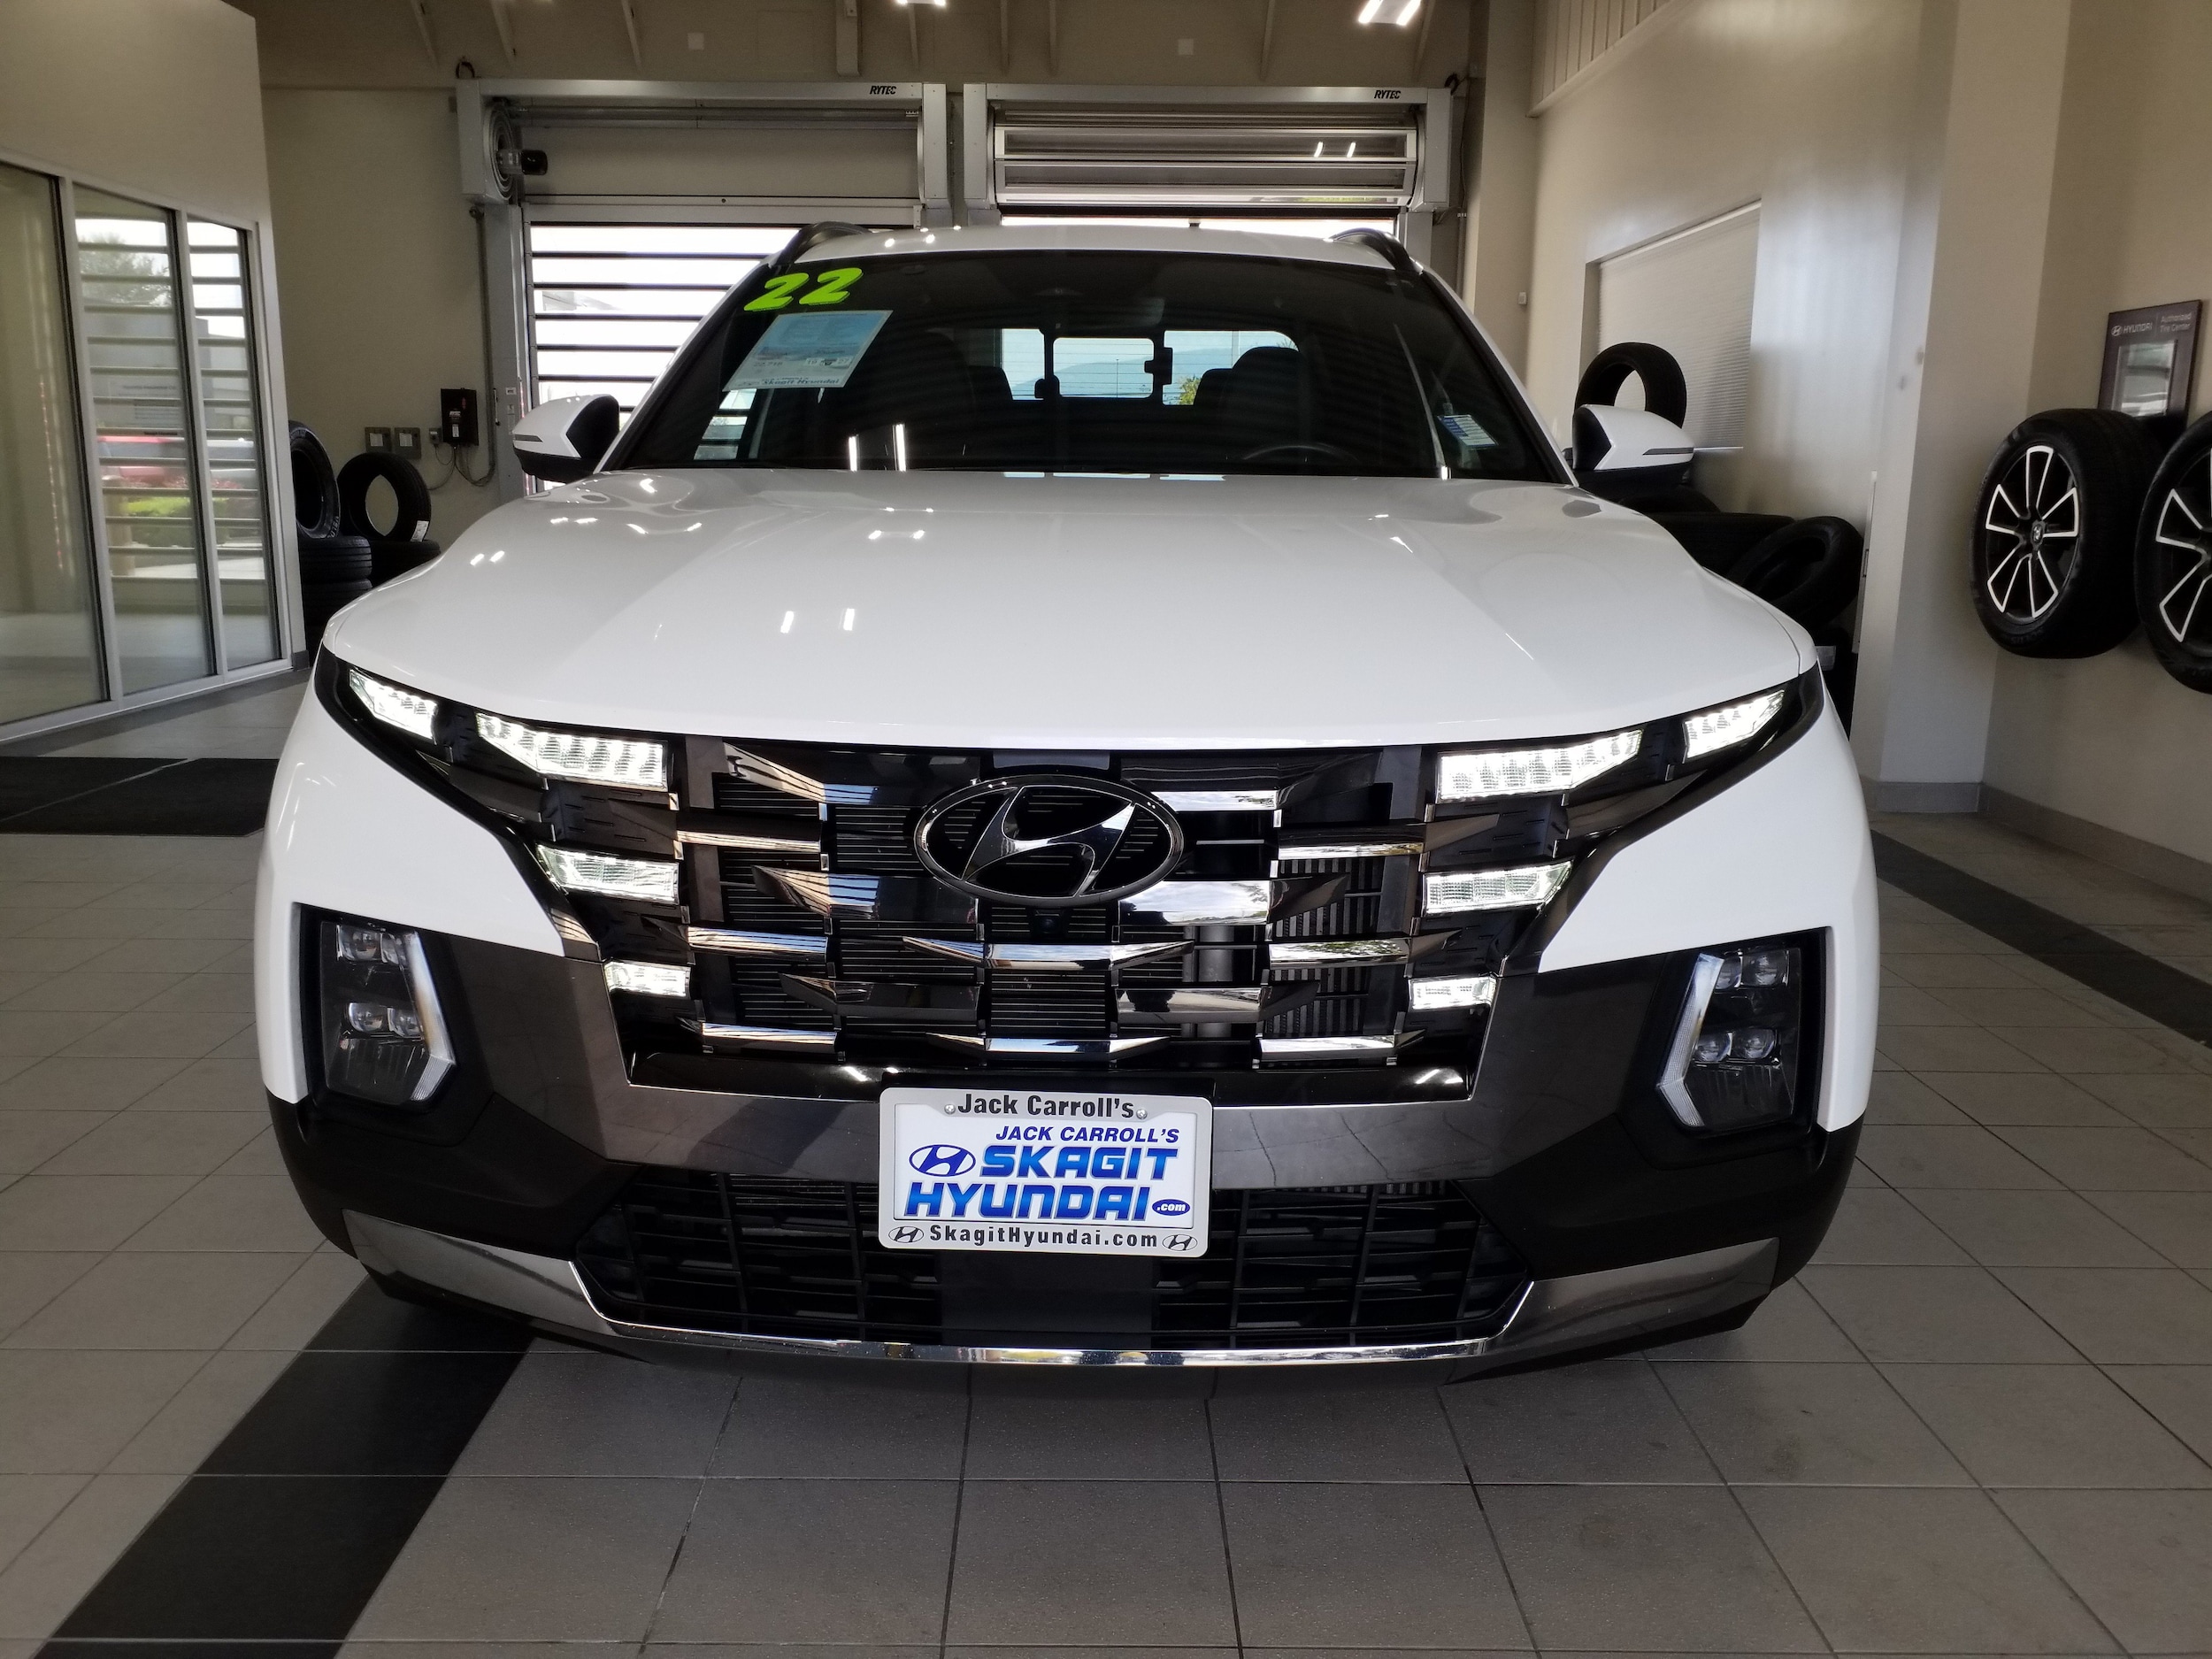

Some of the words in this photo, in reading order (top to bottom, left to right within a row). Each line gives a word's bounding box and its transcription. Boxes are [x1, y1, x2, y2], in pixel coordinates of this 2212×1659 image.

[870, 85, 897, 95] RYTEC
[1373, 89, 1402, 99] RYTEC
[743, 267, 864, 311] 22
[2124, 322, 2153, 334] HYUNDAI
[957, 1094, 1018, 1115] Jack
[1027, 1094, 1134, 1119] Carroll's
[995, 1125, 1053, 1141] JACK
[1060, 1126, 1179, 1143] CARROLL'S
[979, 1144, 1179, 1181] SKAGIT
[903, 1181, 1150, 1221] HYUNDAI
[1156, 1202, 1187, 1212] .com
[929, 1225, 1157, 1248] SkagitHyundai.com
